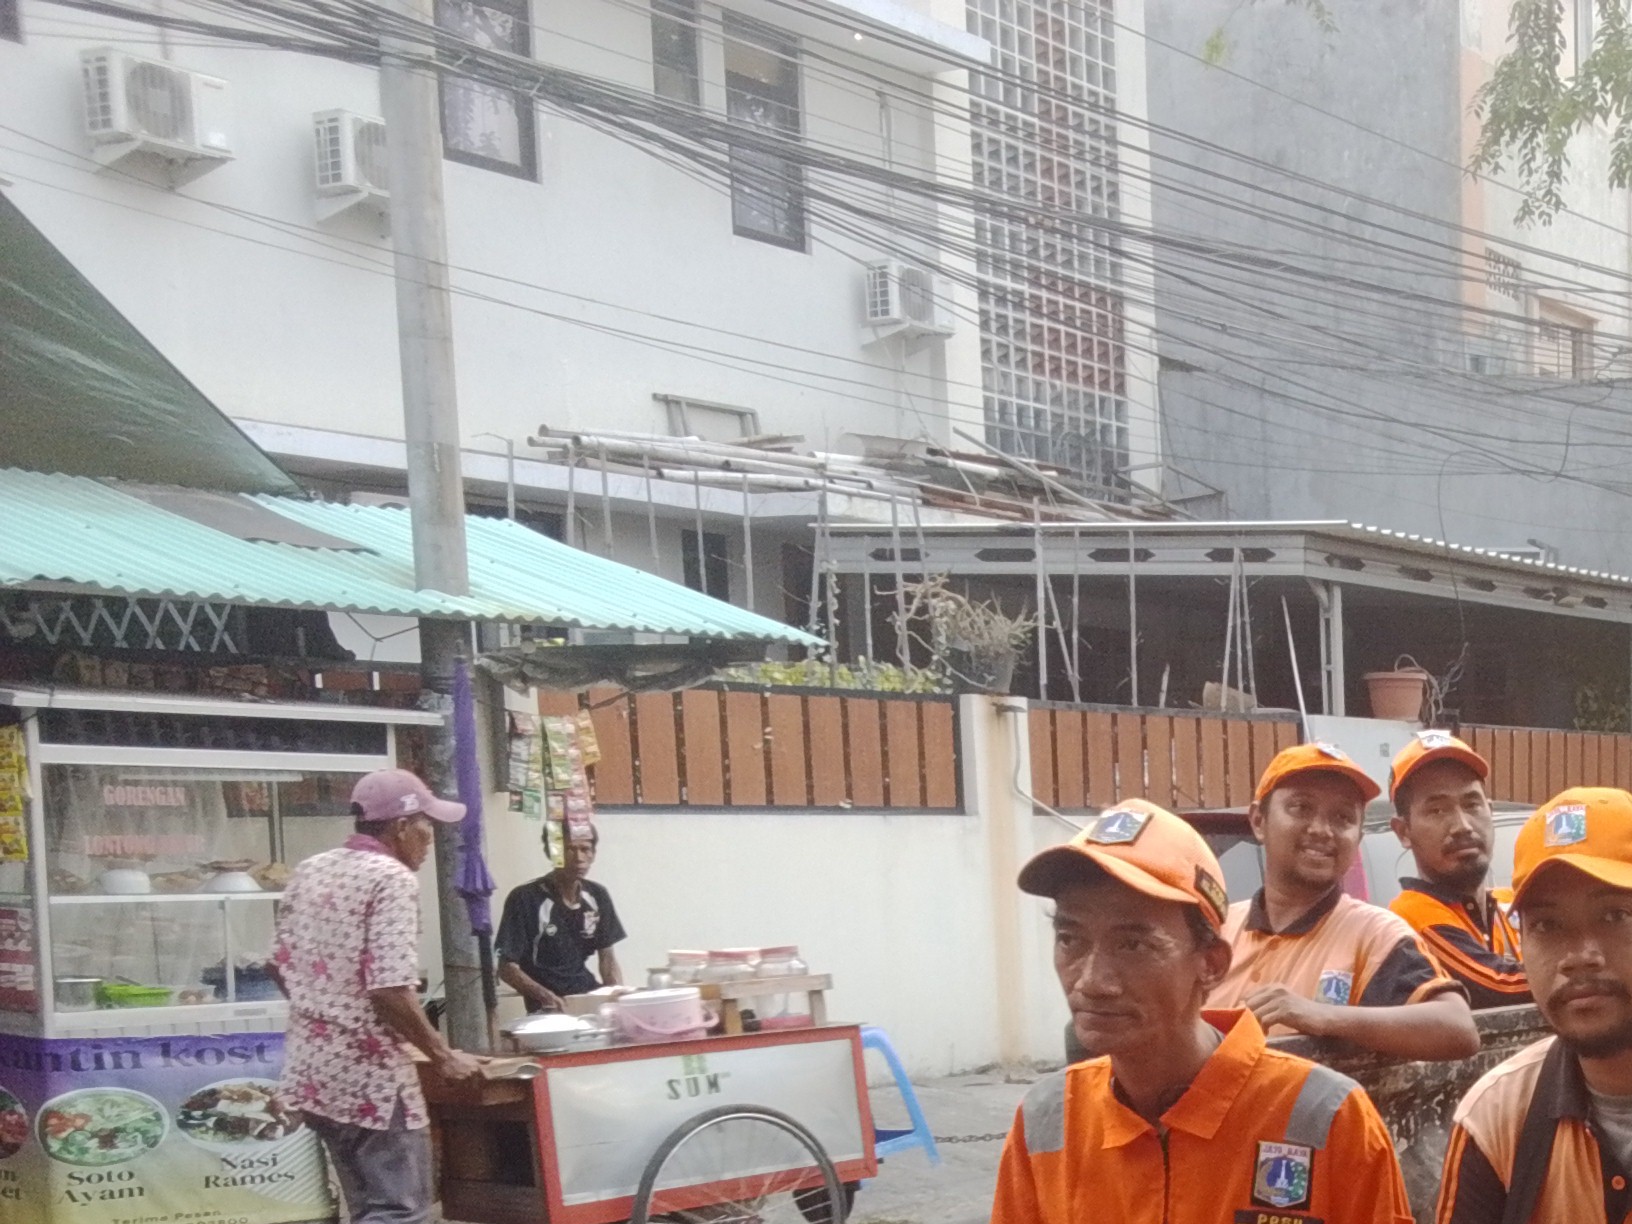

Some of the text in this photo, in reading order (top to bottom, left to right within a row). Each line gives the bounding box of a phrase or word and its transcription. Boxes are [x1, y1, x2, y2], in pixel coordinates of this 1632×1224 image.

[103, 785, 186, 806] GORENGAN
[160, 1040, 275, 1068] kost
[220, 1153, 279, 1172] Nasi
[66, 1169, 136, 1187] Soto
[203, 1169, 296, 1190] Rames
[57, 1184, 146, 1207] Ayam
